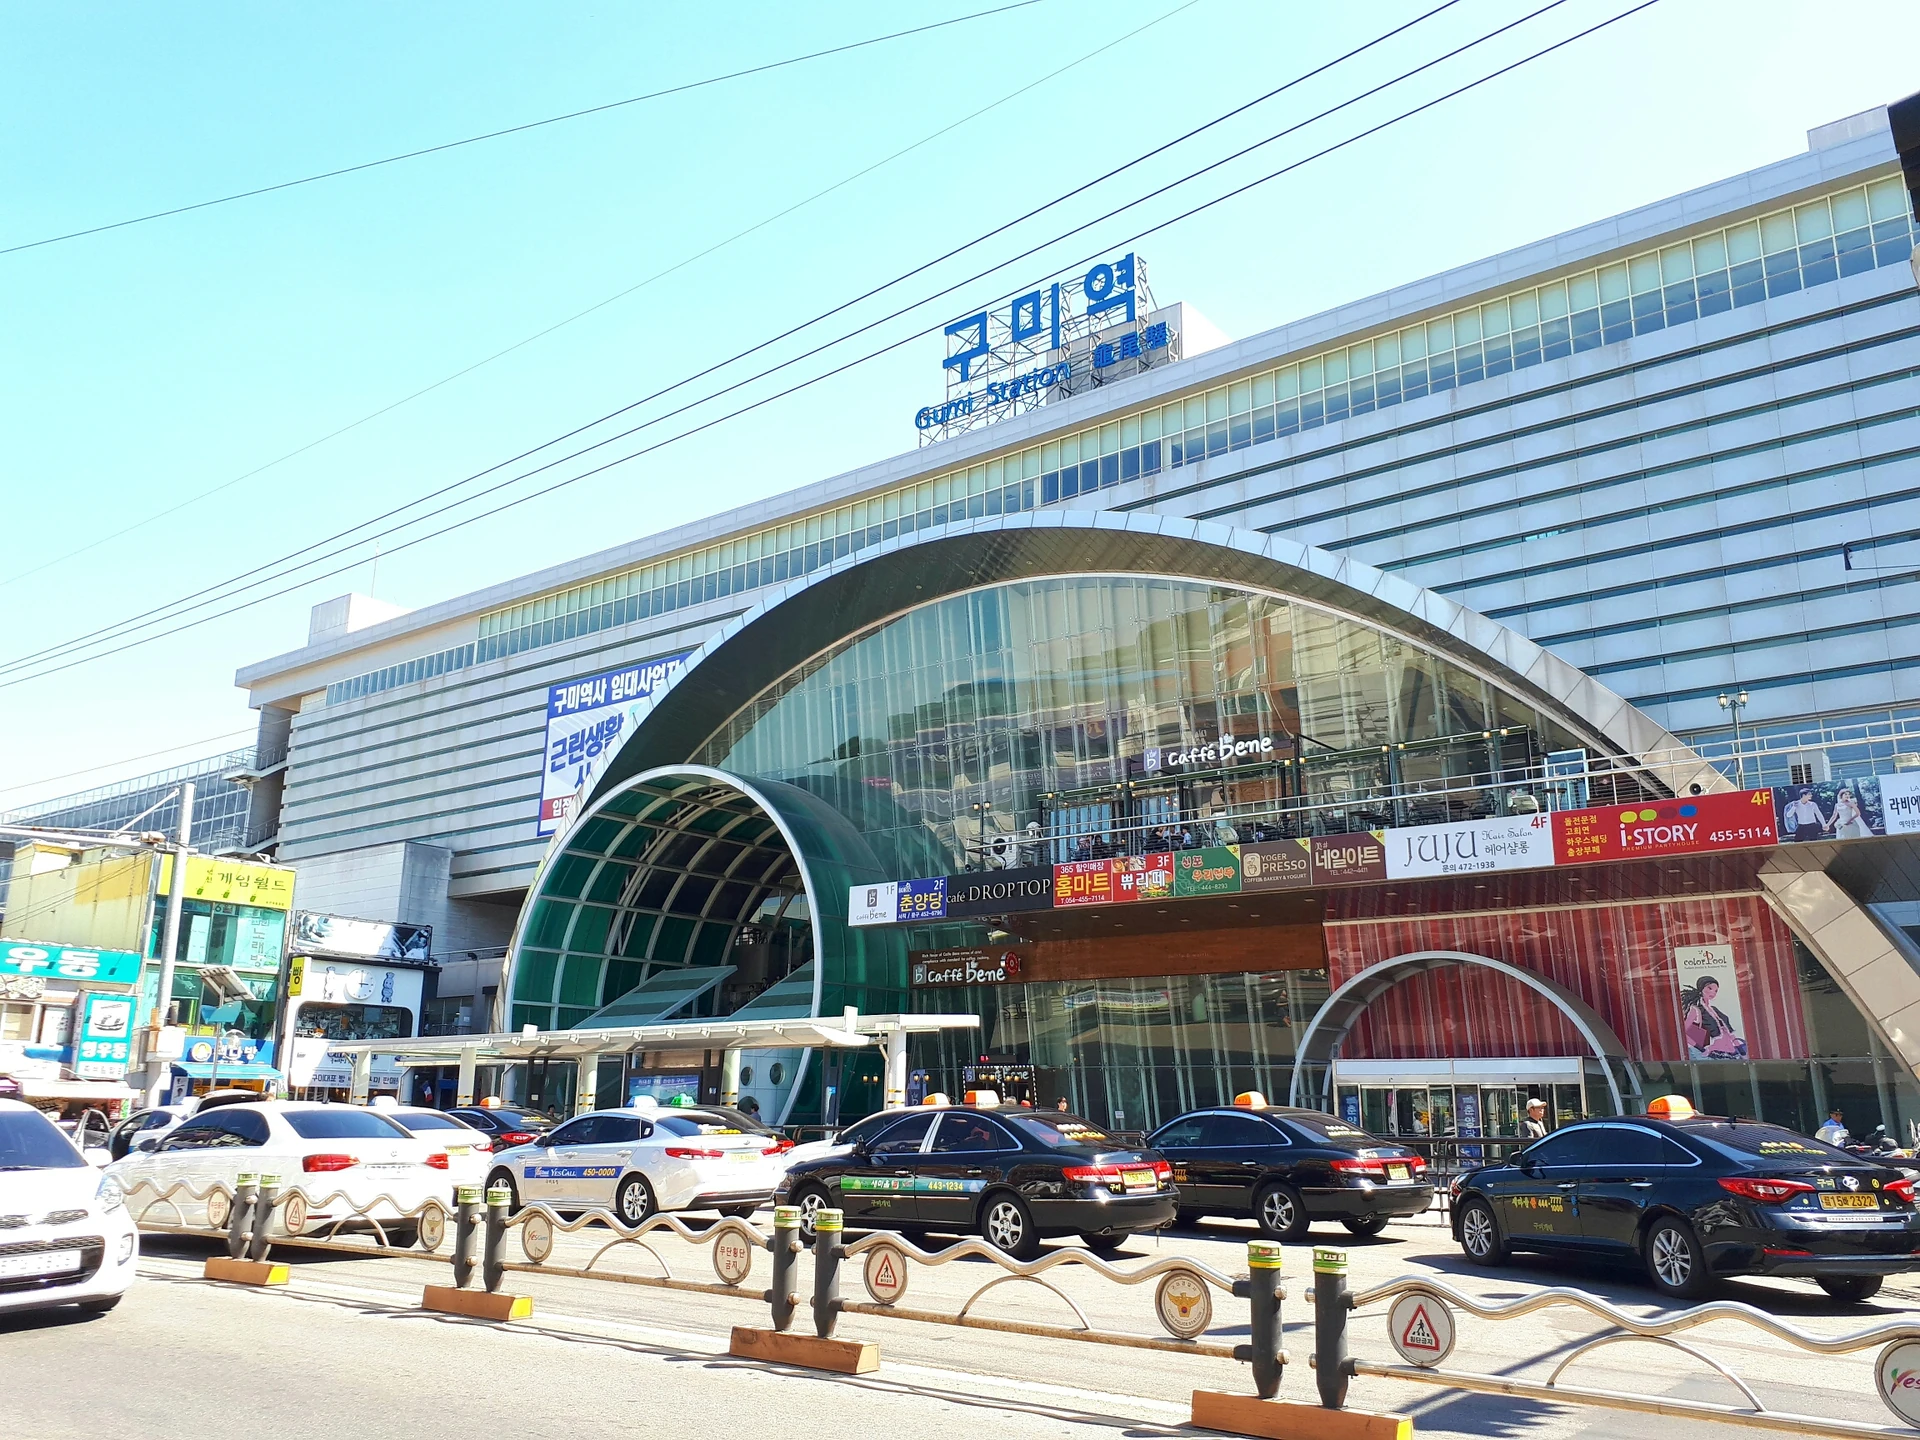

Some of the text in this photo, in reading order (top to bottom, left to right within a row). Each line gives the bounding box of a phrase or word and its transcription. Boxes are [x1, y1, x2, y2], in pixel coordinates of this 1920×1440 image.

[943, 252, 1136, 383] 구미역
[915, 362, 1071, 430] Gumi Station
[554, 676, 608, 714] 구미역사
[550, 712, 624, 773] 근린생활
[1219, 733, 1274, 761] bene
[1750, 790, 1771, 807] 4F
[1530, 816, 1548, 829] 4F
[1564, 815, 1597, 827] 돌전문점
[1482, 827, 1533, 841] Hair Salon
[1709, 826, 1772, 843] 455-5114
[1404, 830, 1479, 867] JUJU
[1622, 840, 1700, 852] PREMIUM PARTYHOUSE
[1157, 855, 1170, 867] 3F
[1181, 855, 1203, 869] 신포
[1261, 853, 1287, 861] YOGER
[1315, 845, 1381, 870] 네일아트
[1060, 861, 1104, 874] 365 할인매장
[1262, 859, 1307, 873] PRESSO
[1442, 861, 1496, 873] 문의 472-1938
[1192, 865, 1235, 882] 우리만두
[218, 871, 287, 892] 게임월드
[933, 880, 944, 891] 2F
[1055, 872, 1110, 897] 홈마트
[885, 885, 895, 896] 1F
[946, 878, 1051, 904] café DROPTOP
[900, 892, 943, 912] 춘양당
[5, 946, 101, 977] 우동
[965, 959, 1006, 983] bene
[583, 1167, 616, 1176] 450-0000
[928, 1180, 964, 1190] 443-1234
[1816, 1178, 1836, 1189] 구미
[1850, 1195, 1874, 1207] 2322
[719, 1246, 745, 1258] 무단횡단
[725, 1259, 738, 1270] 금지
